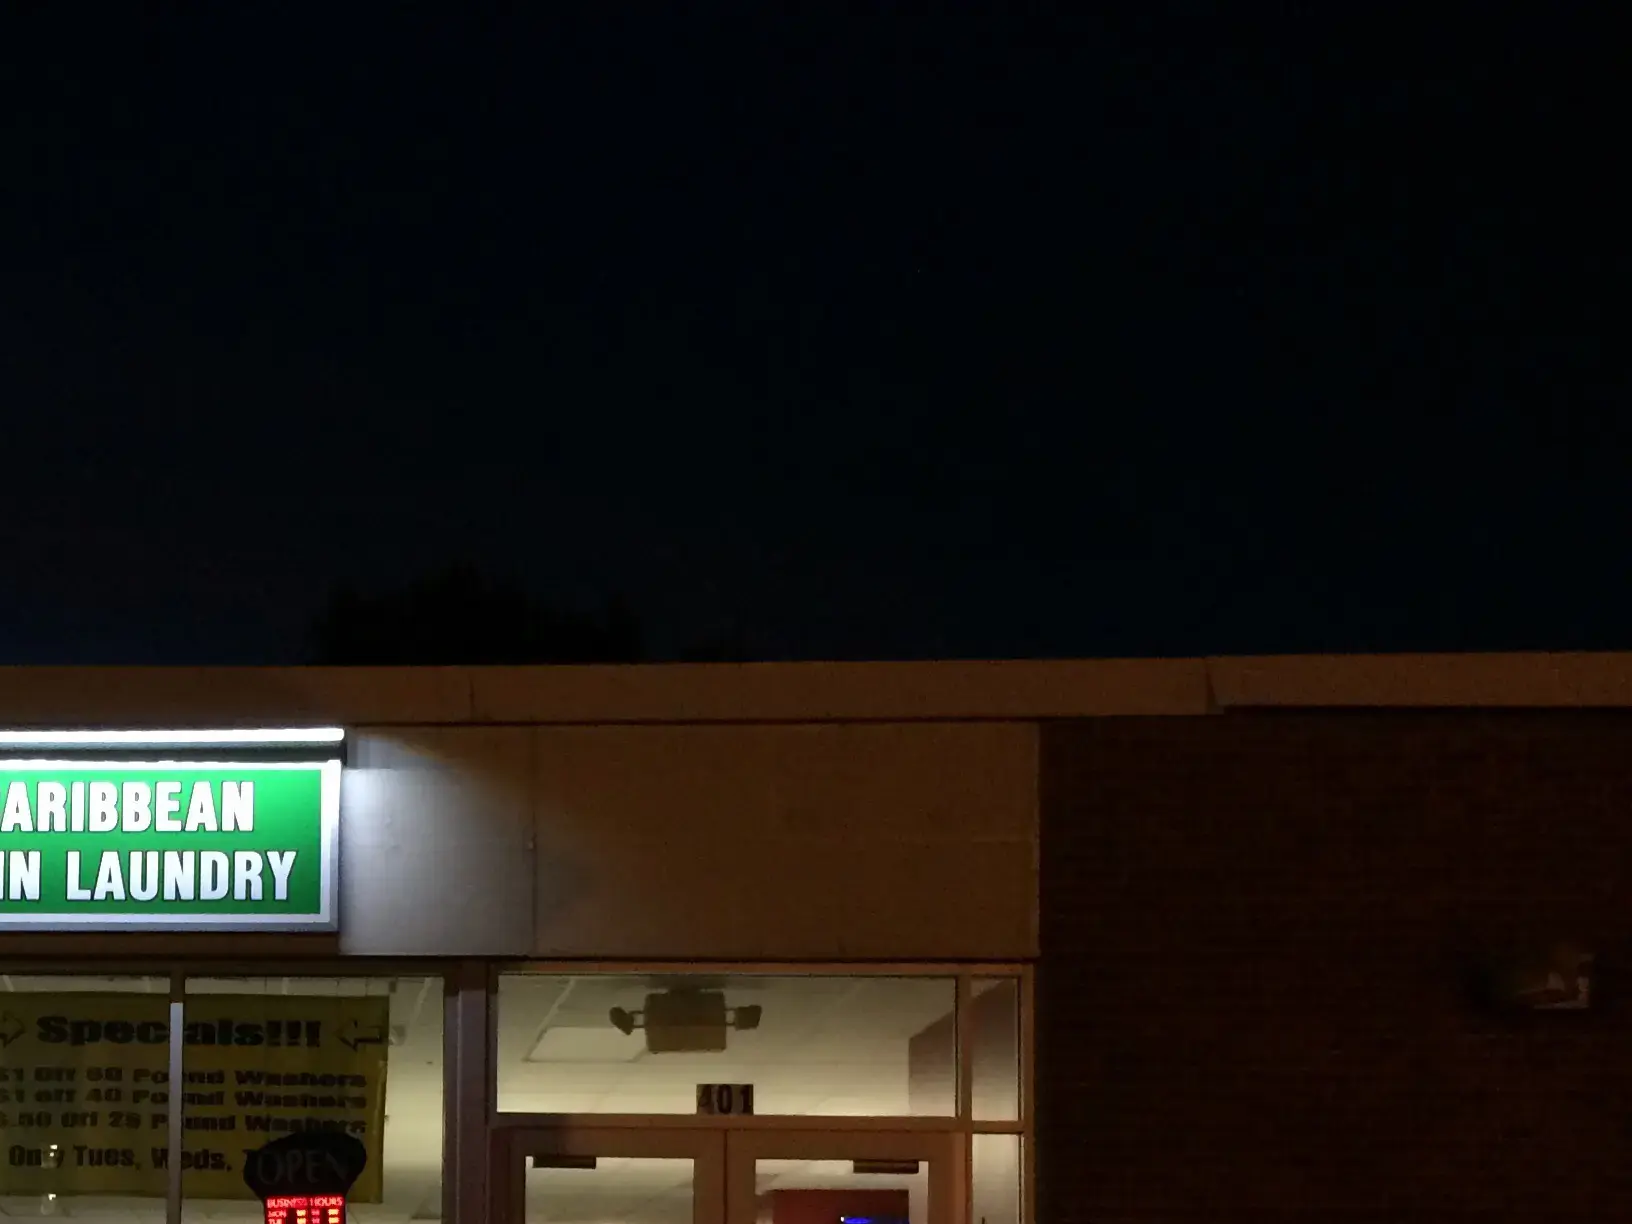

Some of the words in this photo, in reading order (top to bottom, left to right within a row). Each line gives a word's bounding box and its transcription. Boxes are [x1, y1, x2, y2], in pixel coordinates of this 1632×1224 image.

[65, 849, 298, 901] LAUNDRY
[36, 1016, 322, 1047] Specals!!!
[133, 1068, 224, 1085] Pond
[133, 1090, 224, 1105] Pond
[697, 1084, 753, 1114] 401
[151, 1113, 235, 1131] Pund
[9, 1145, 65, 1169] Ony
